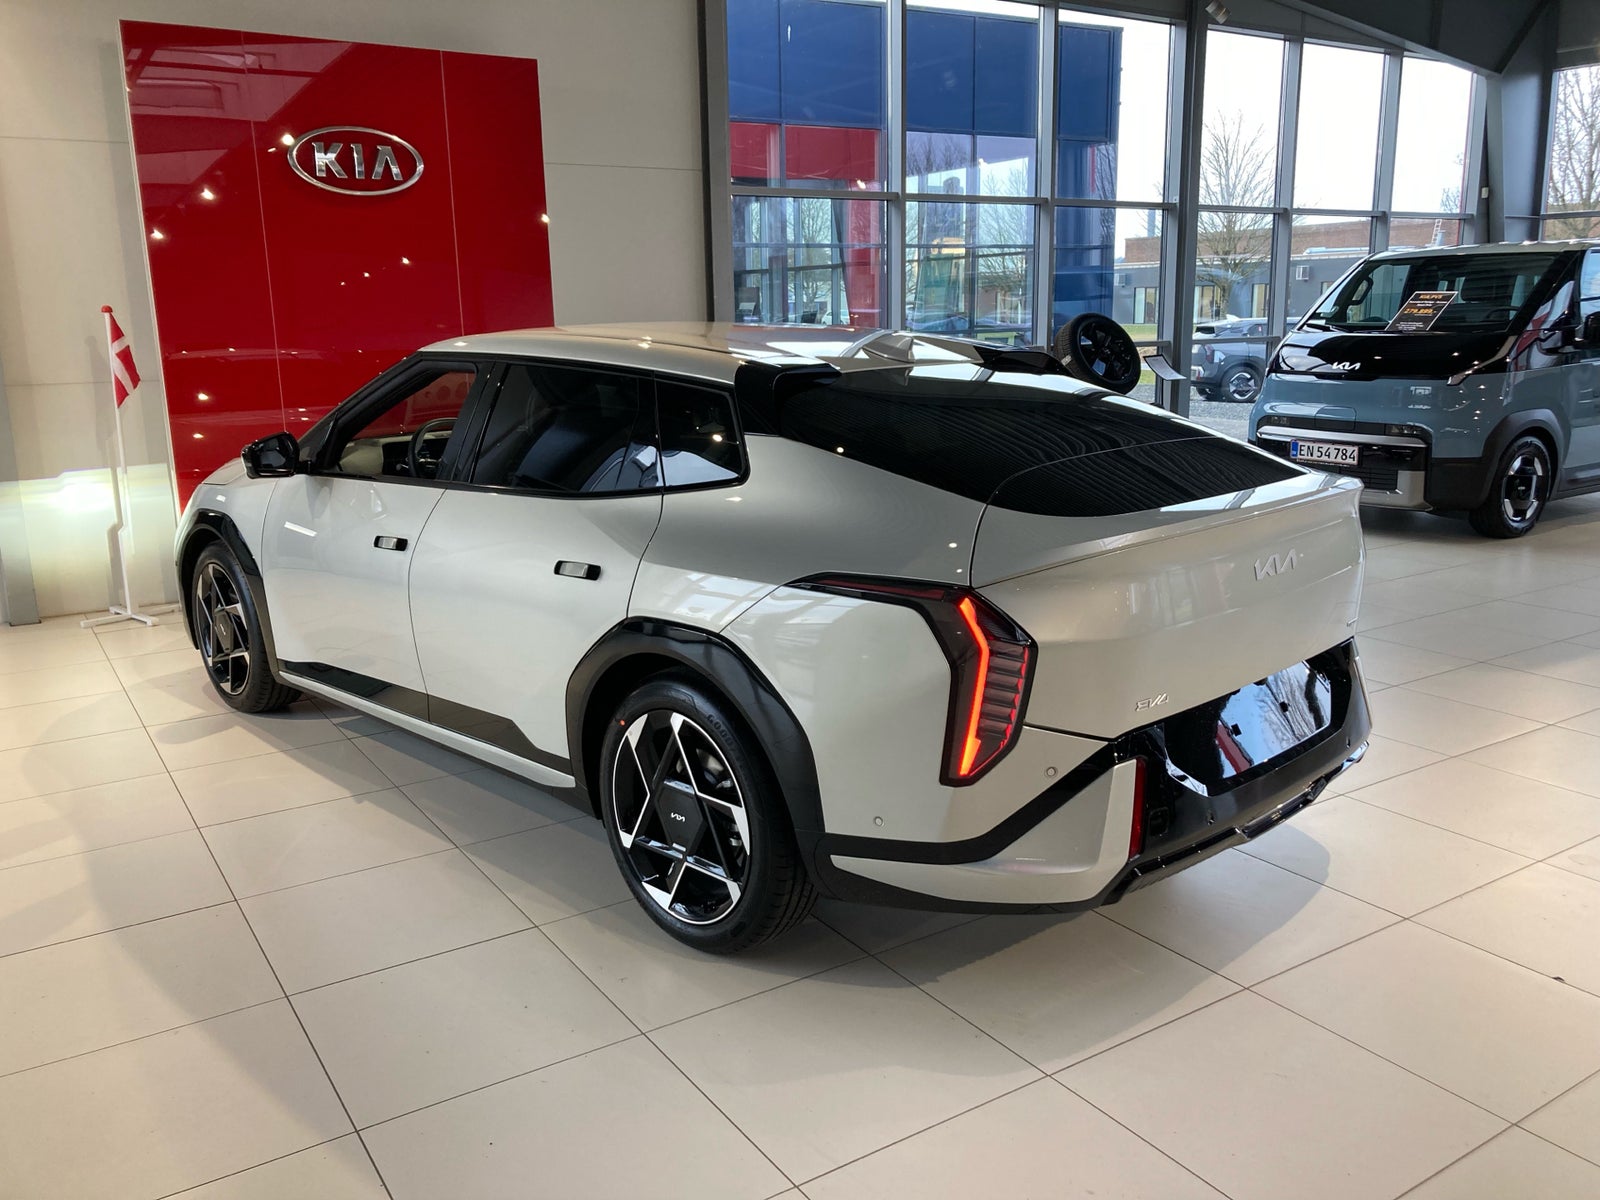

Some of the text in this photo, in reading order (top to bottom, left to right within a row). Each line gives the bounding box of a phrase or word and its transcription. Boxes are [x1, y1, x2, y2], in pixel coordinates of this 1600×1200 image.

[312, 142, 403, 180] KIA
[1332, 361, 1361, 370] KIA
[1299, 444, 1356, 461] EN 54 784
[1253, 549, 1297, 581] KIA
